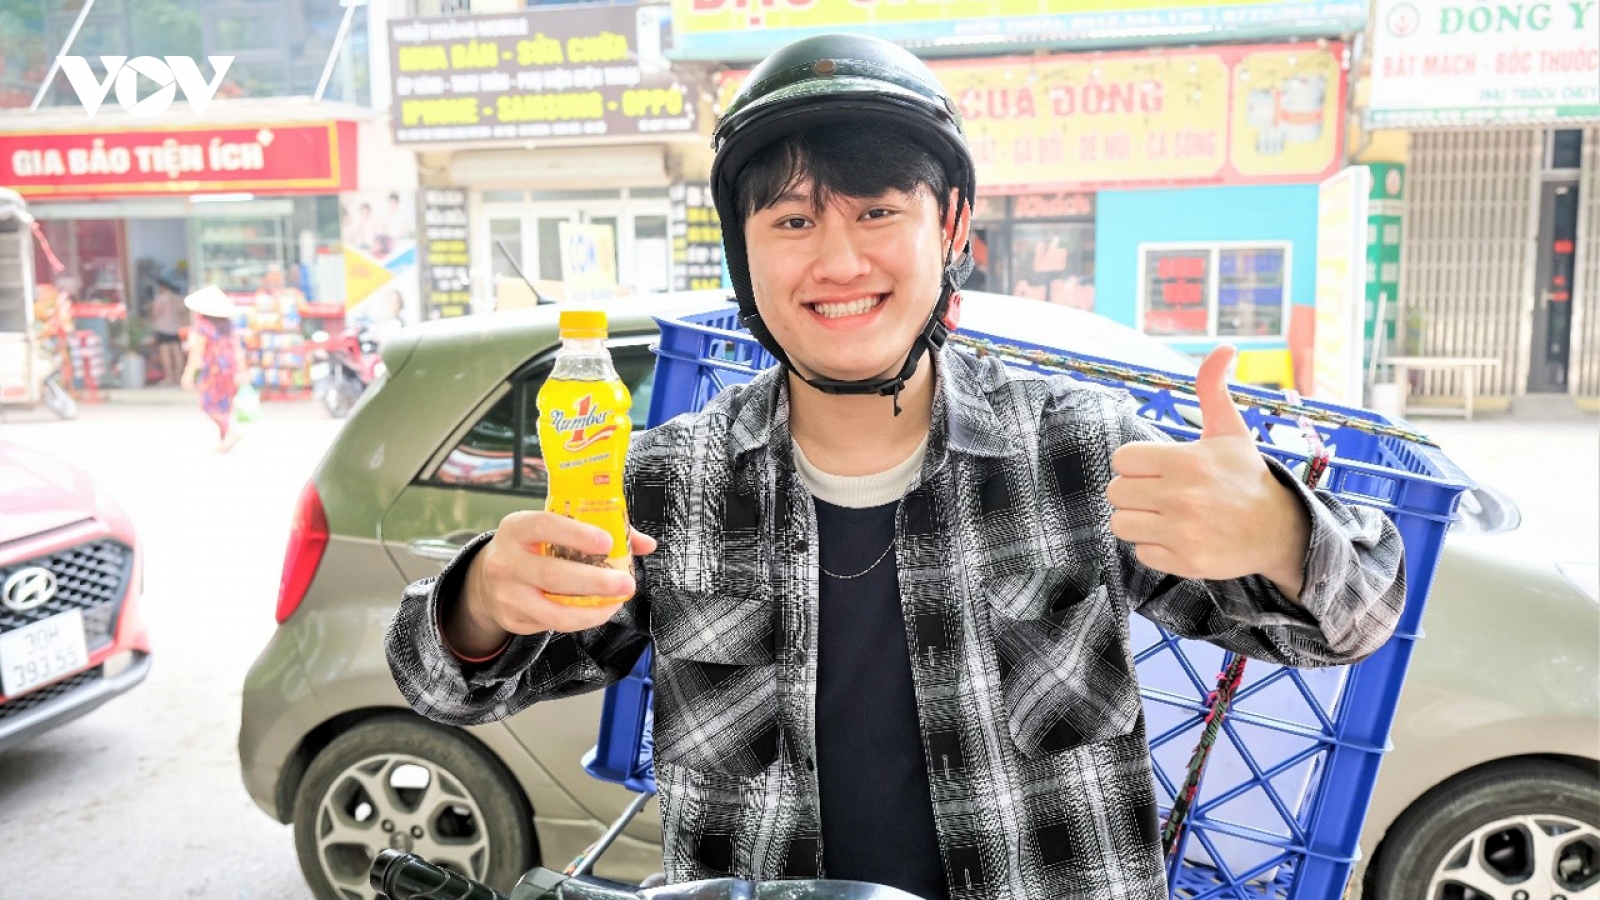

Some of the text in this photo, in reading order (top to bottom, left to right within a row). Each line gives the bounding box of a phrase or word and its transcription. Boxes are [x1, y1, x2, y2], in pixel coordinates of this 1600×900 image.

[399, 31, 628, 71] MUA BÁN SỬA CHỮA
[402, 88, 683, 125] IPHONE SAMSUNG OPPO
[960, 77, 1164, 121] CUA ĐỒNG
[12, 138, 264, 179] GIA BẢO TIỆN ÍCH
[550, 404, 609, 434] Number
[570, 395, 592, 443] 1
